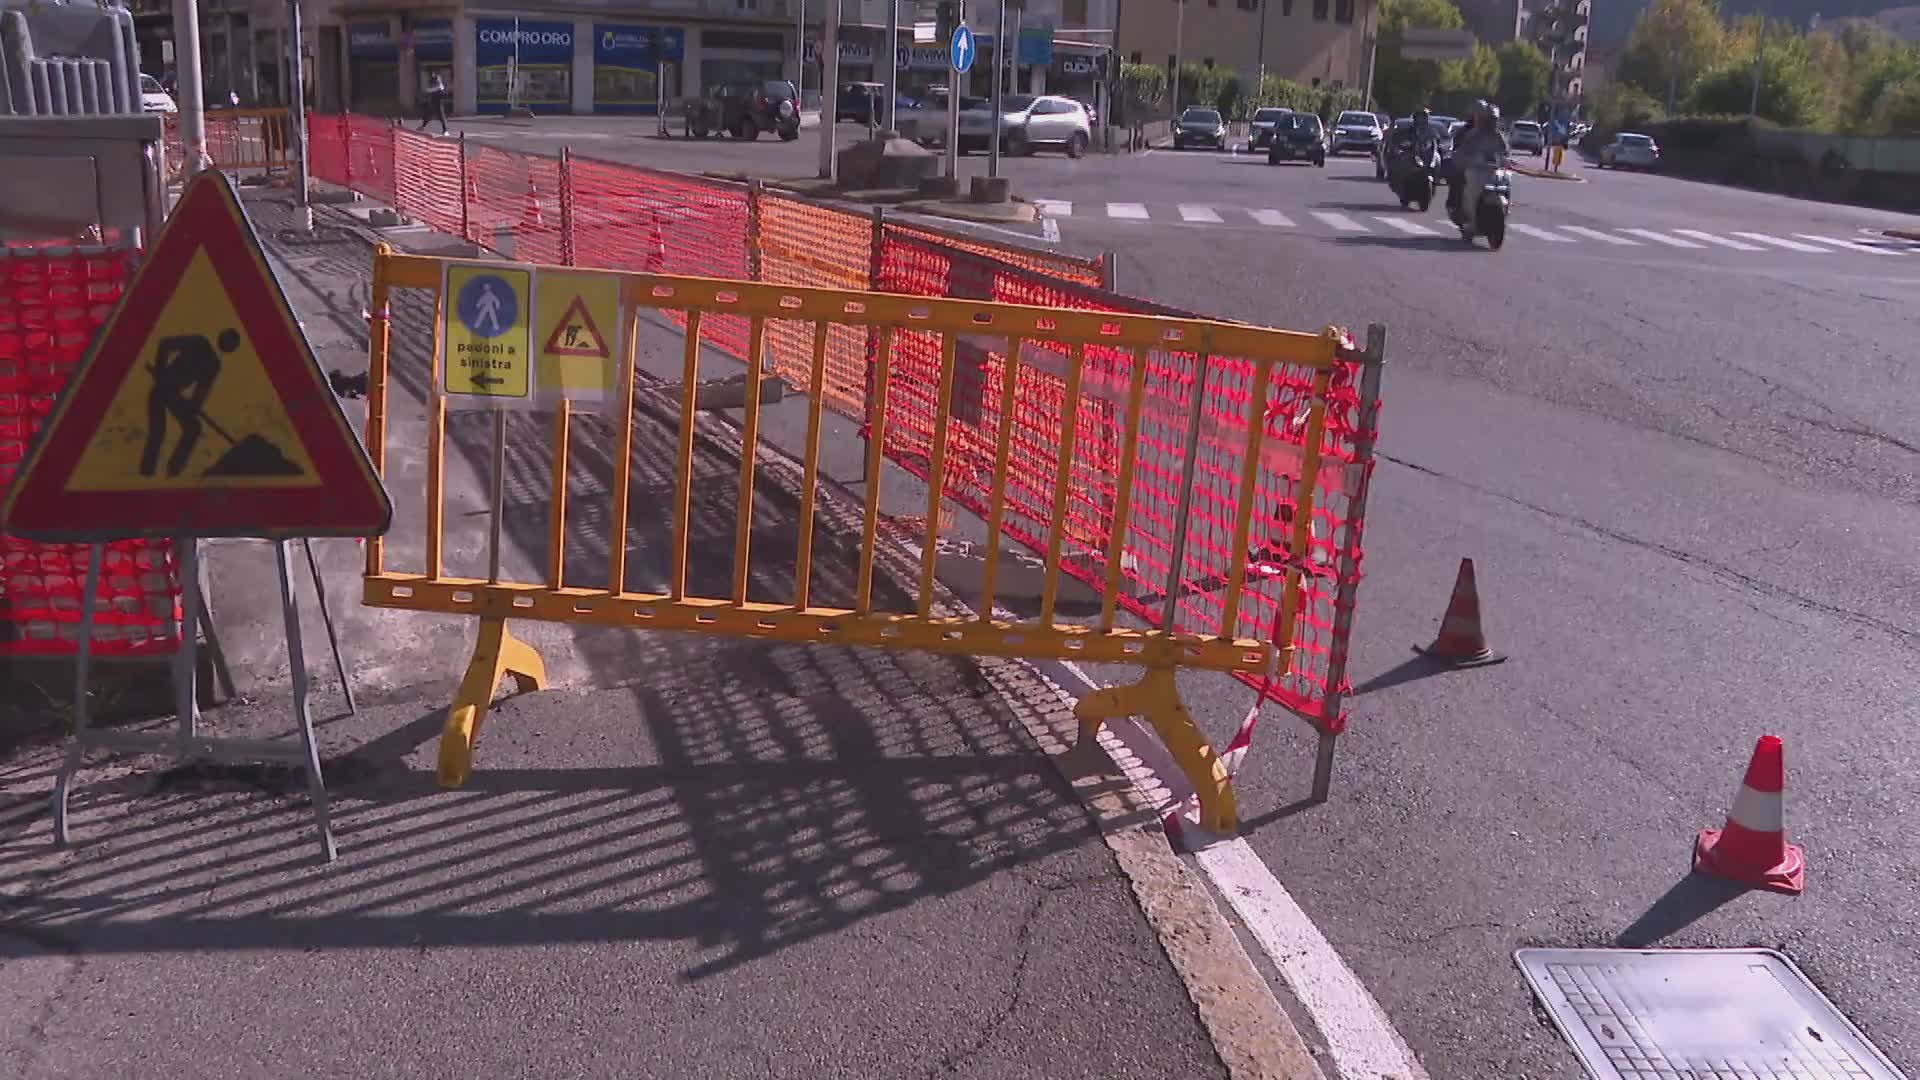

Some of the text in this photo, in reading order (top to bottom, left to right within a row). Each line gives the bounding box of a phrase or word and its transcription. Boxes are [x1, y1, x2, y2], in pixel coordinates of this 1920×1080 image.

[541, 32, 571, 45] ORO
[457, 343, 516, 355] pedoni a
[460, 357, 511, 369] sinistra
